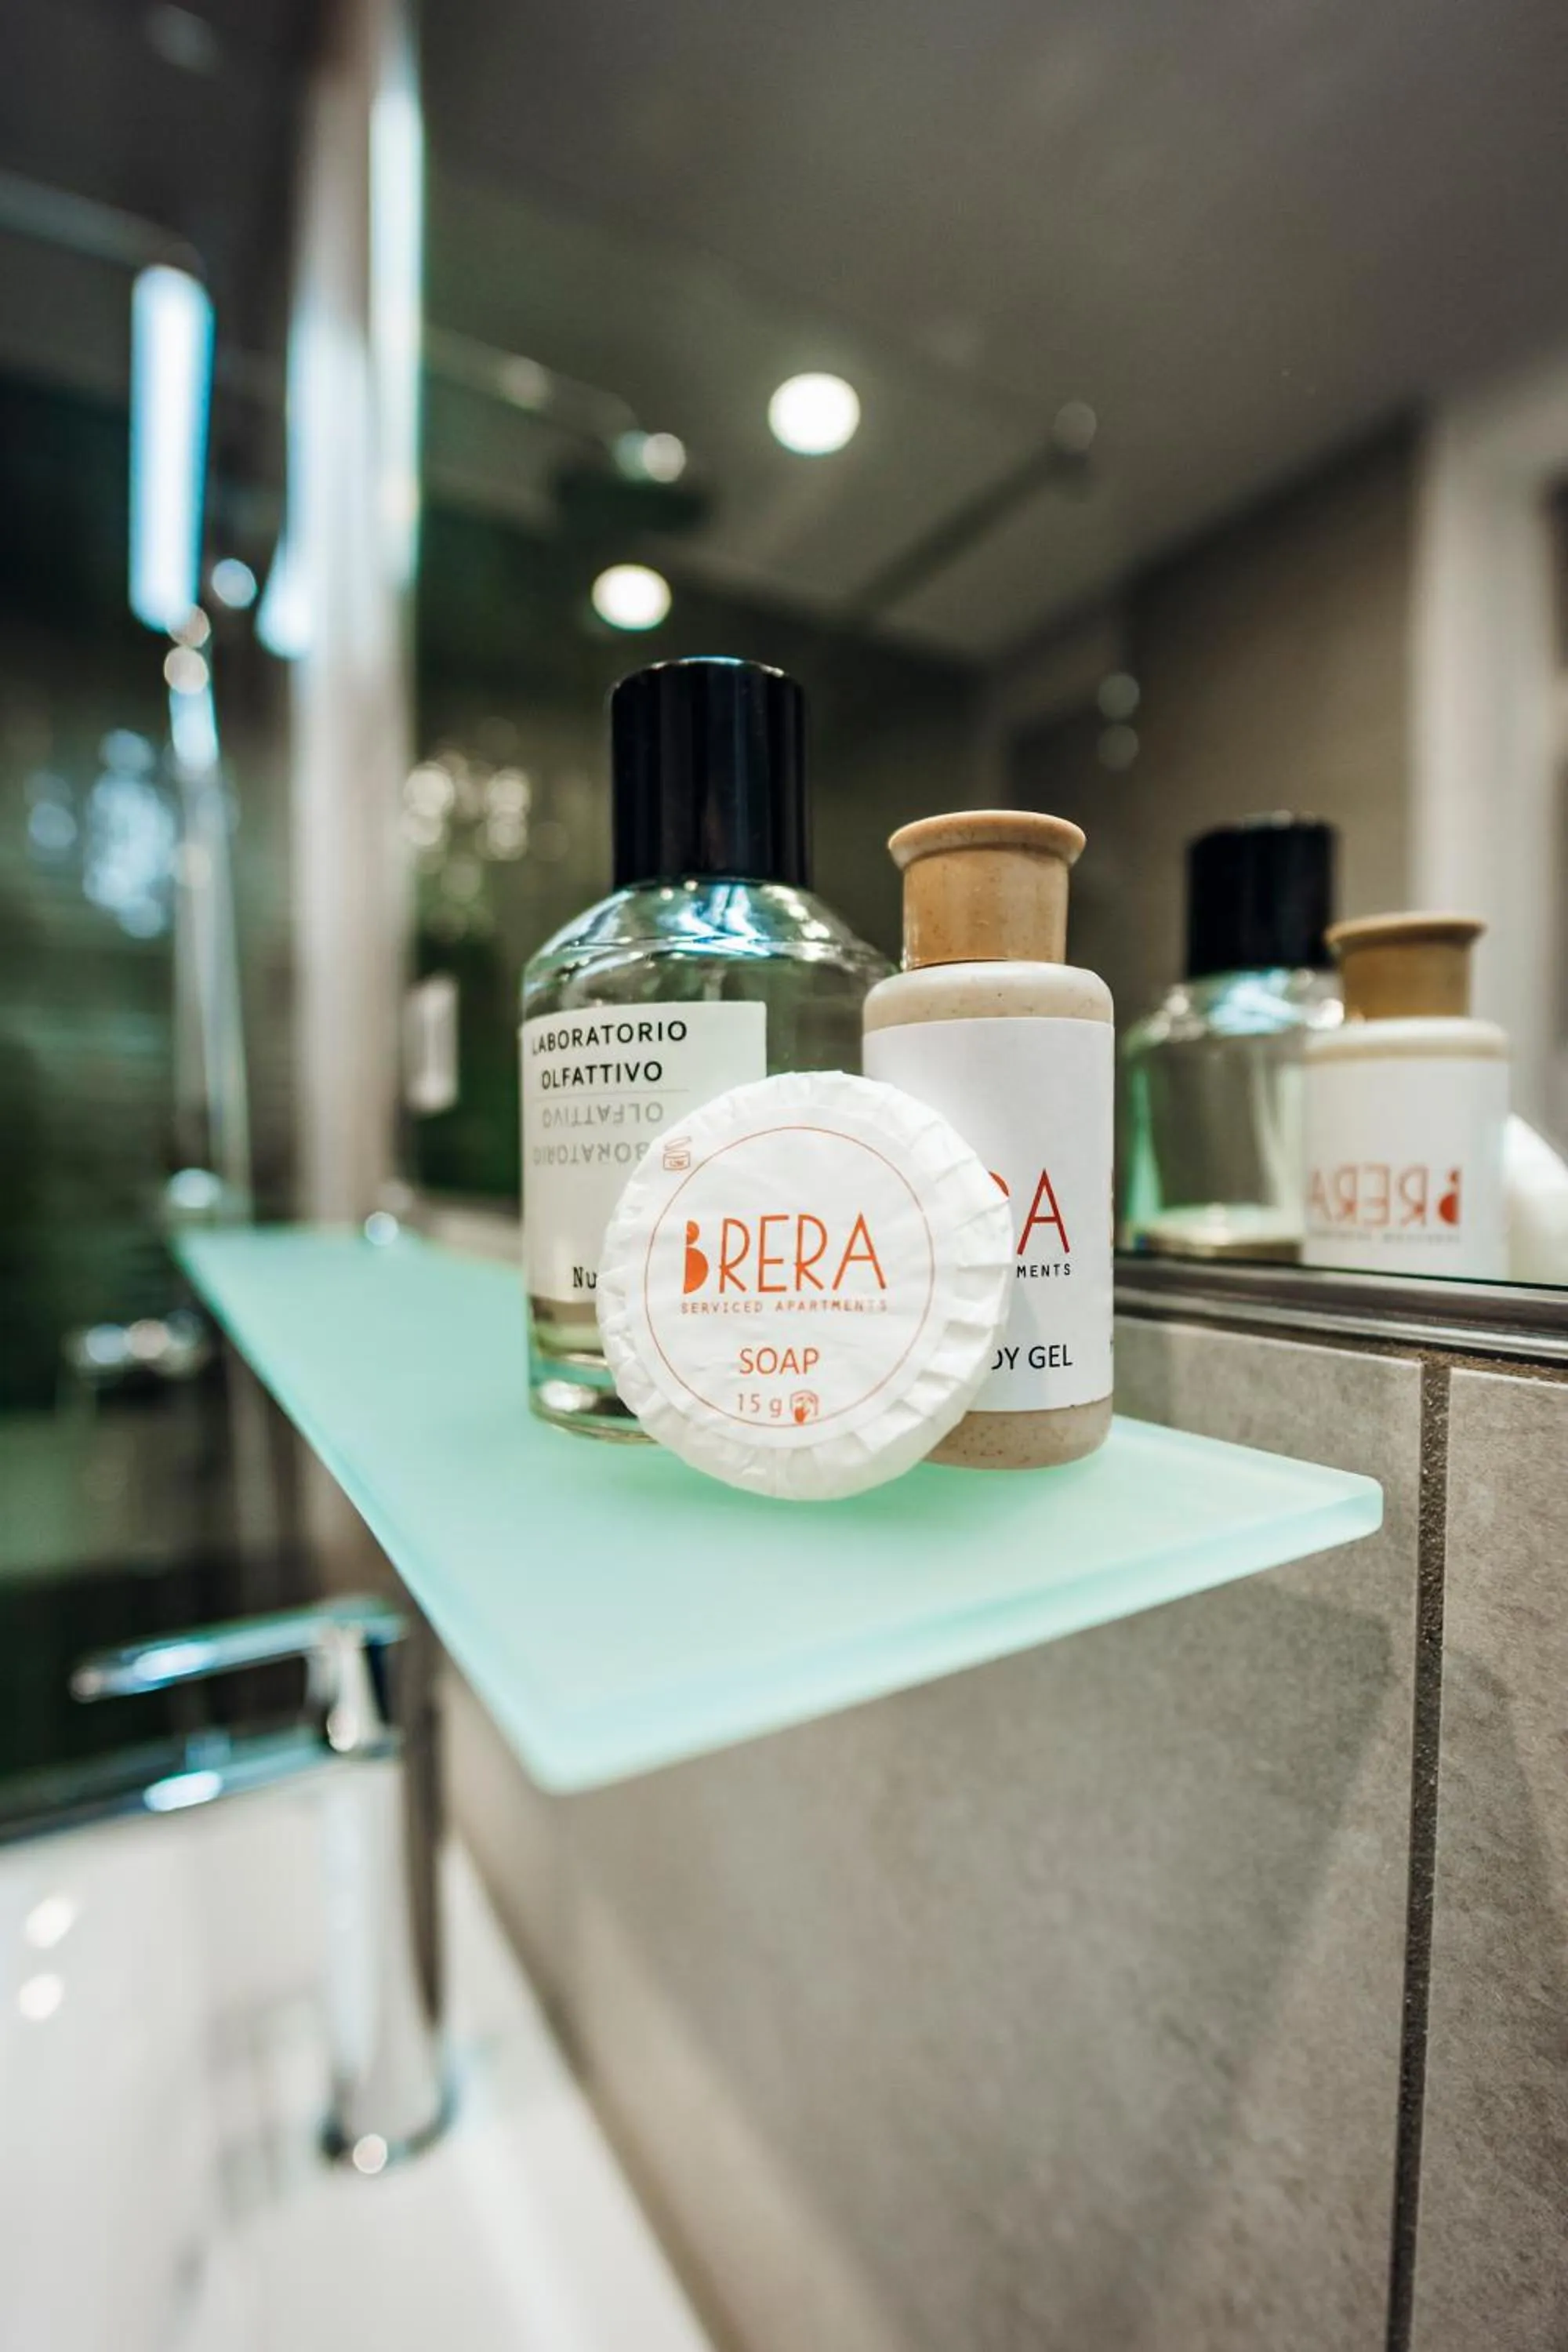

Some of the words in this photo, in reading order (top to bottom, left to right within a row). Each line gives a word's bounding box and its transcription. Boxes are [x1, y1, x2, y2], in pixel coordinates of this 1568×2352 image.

[532, 1020, 688, 1055] LABORATORIO
[541, 1061, 663, 1090] OLFATTIVO
[532, 1140, 650, 1166] BORATORIO
[683, 1211, 887, 1294] BRERA
[1016, 1263, 1071, 1279] MENTS
[681, 1301, 764, 1315] SERVICED
[739, 1347, 820, 1375] SOAP
[1028, 1344, 1073, 1370] GEL
[737, 1392, 761, 1413] 15
[769, 1398, 782, 1418] g
